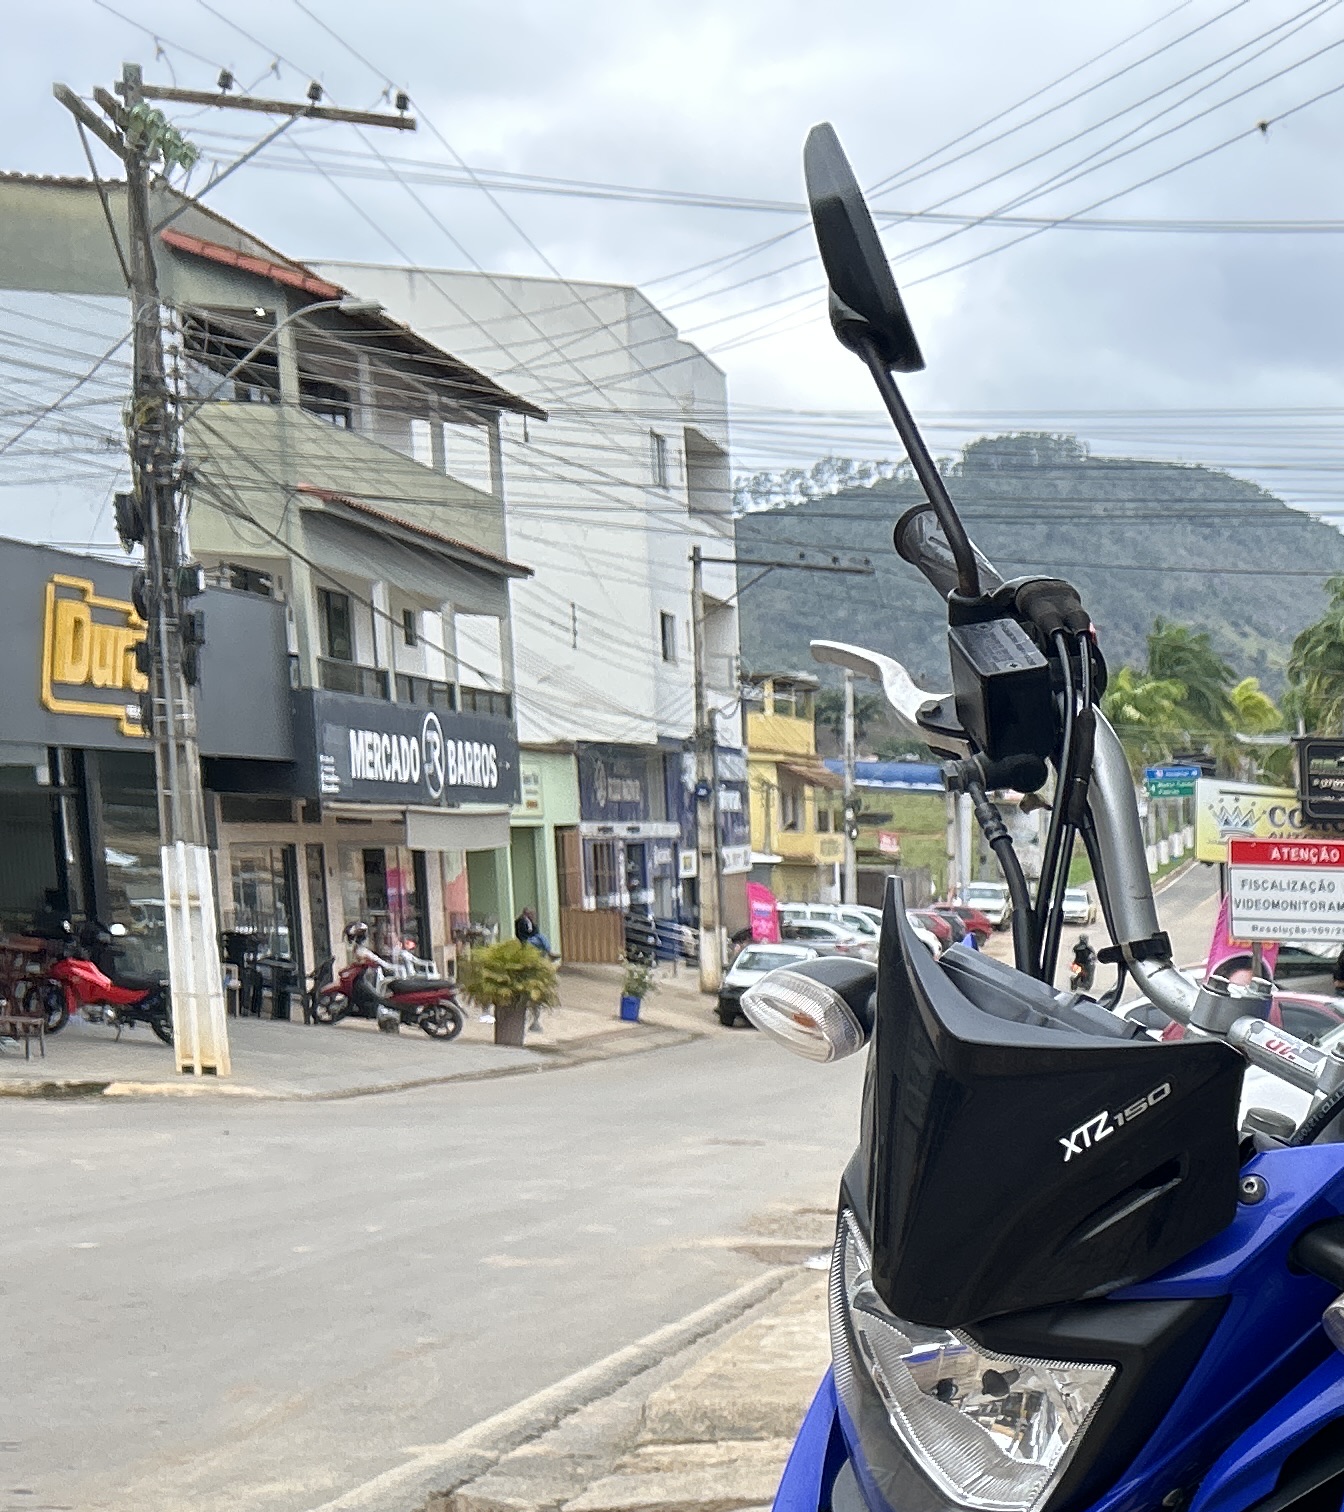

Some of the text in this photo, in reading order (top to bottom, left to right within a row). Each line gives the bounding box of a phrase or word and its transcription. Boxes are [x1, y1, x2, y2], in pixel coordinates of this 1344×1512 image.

[350, 728, 421, 784] MERCADO
[446, 738, 499, 789] BARROS
[1270, 846, 1341, 865] ATENÇÃO
[1239, 878, 1336, 895] FISCALIZAÇÃO
